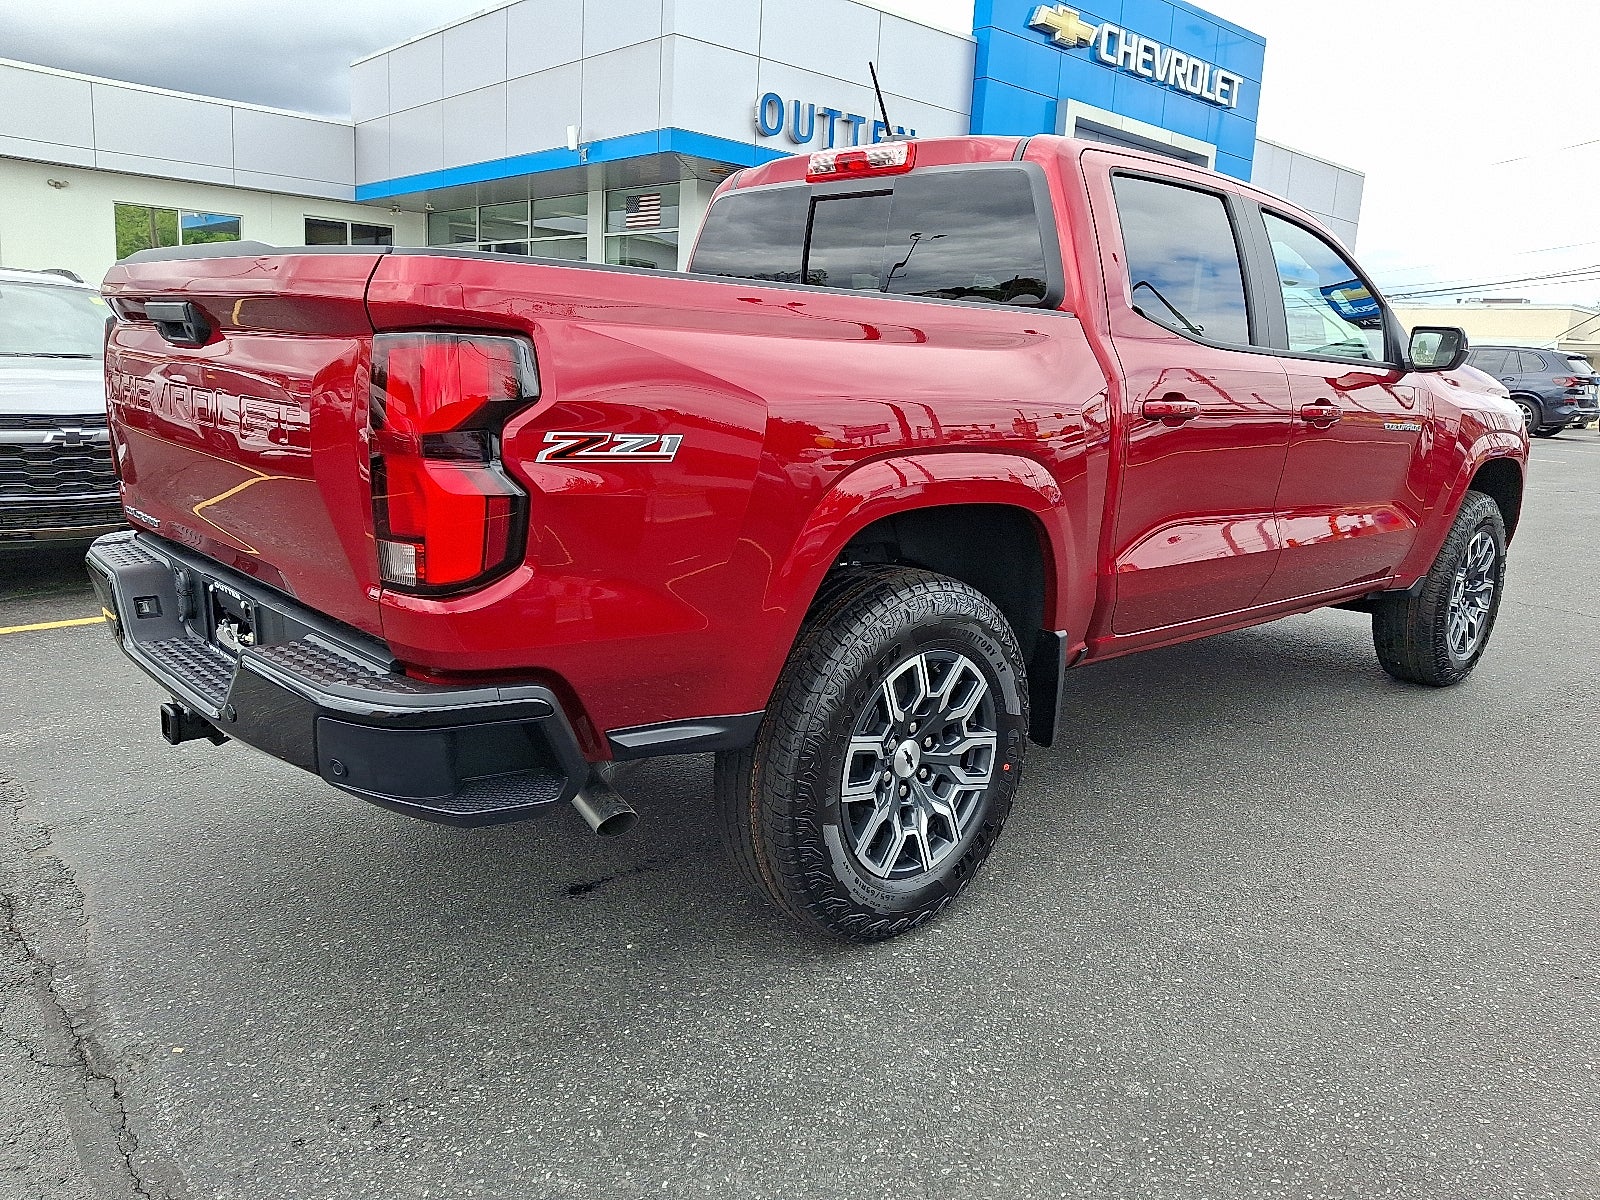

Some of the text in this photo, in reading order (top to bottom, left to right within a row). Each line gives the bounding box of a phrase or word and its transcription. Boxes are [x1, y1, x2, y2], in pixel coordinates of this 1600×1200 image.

[1096, 22, 1244, 109] CHEVROLET
[754, 92, 916, 149] OUTTE
[108, 373, 301, 444] CHEVROLET
[535, 432, 684, 462] Z71
[995, 661, 1007, 673] AT
